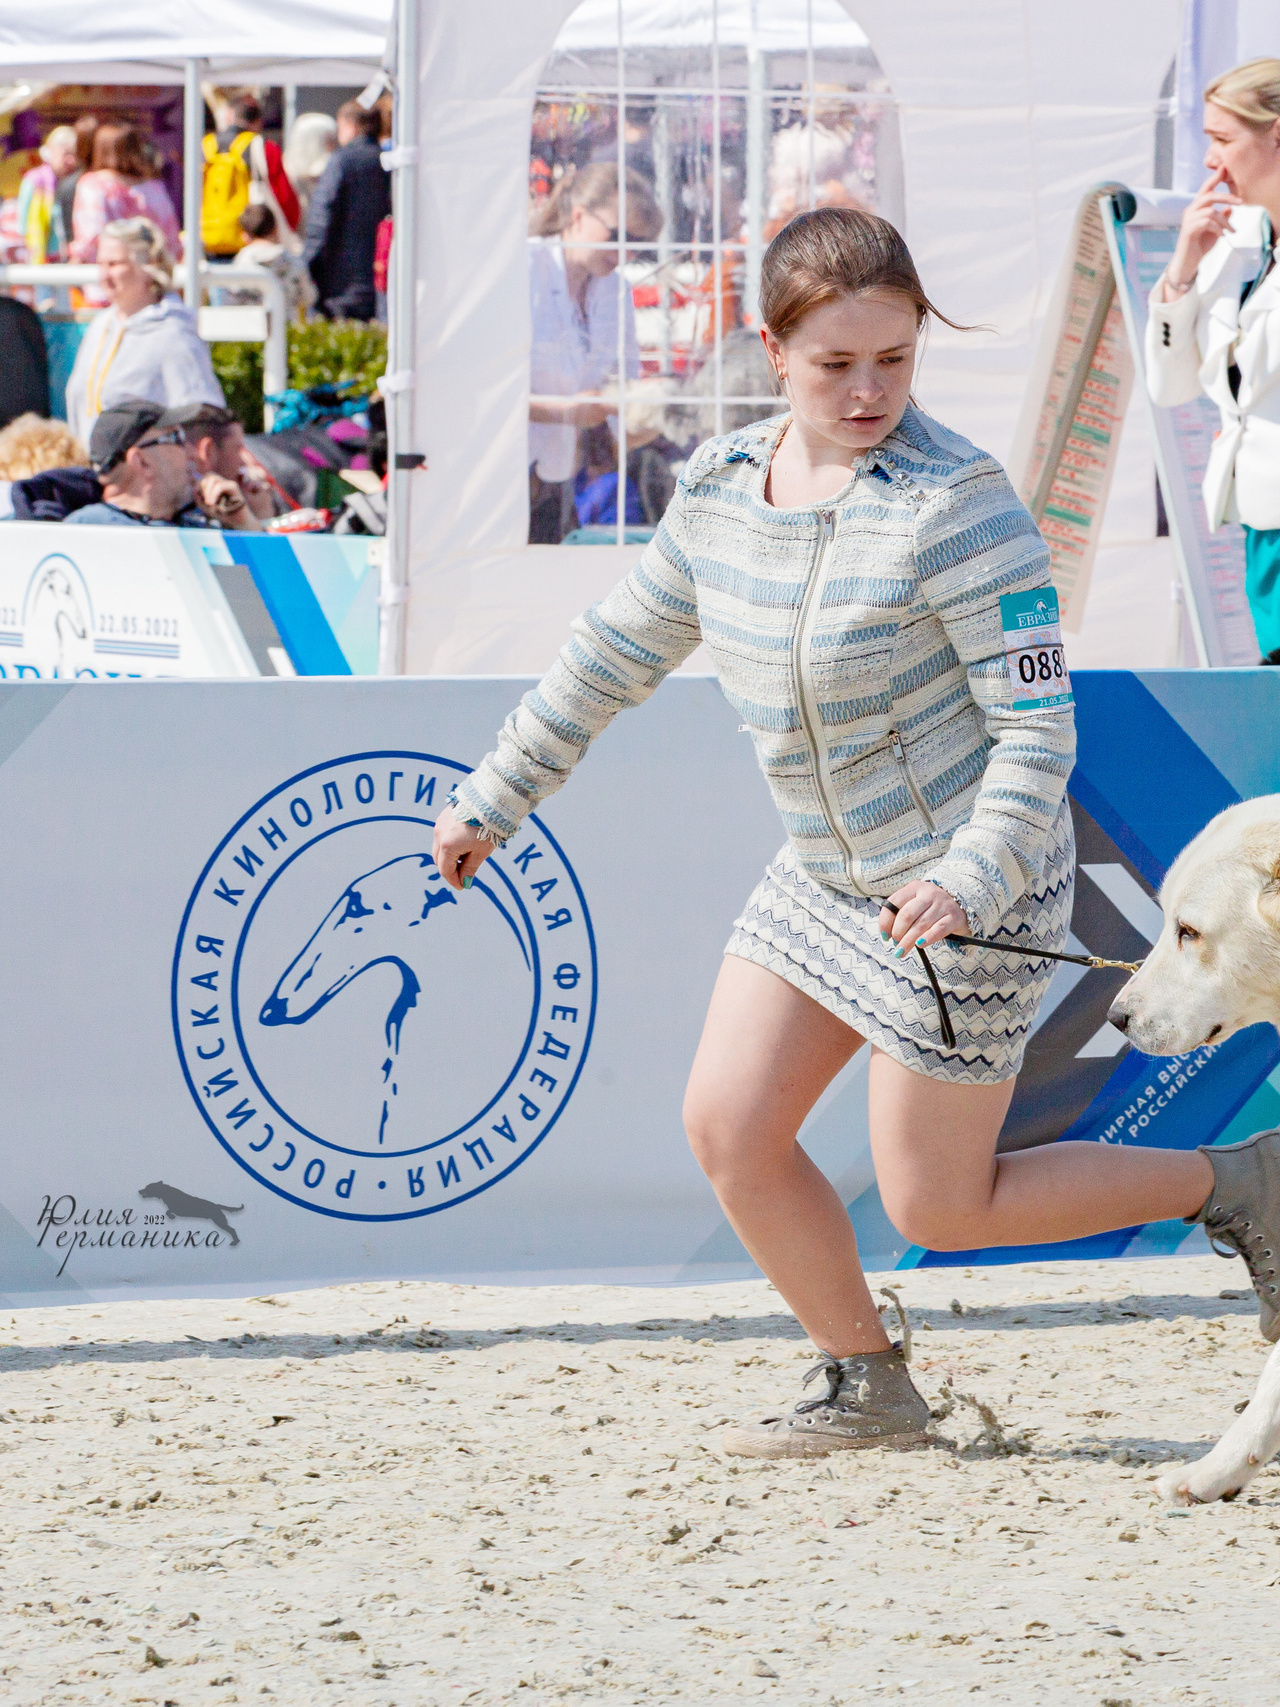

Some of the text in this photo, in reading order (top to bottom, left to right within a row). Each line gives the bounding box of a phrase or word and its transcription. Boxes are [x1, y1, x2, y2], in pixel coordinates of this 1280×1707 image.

[100, 614, 179, 638] 22.05.2022
[1019, 648, 1067, 684] 088
[190, 771, 582, 1199] РОССИЙСКАЯ КИНОЛОГИКАЯ ФЕДЕРАЦИЯ
[1128, 1043, 1222, 1138] РОССИЙСКИ
